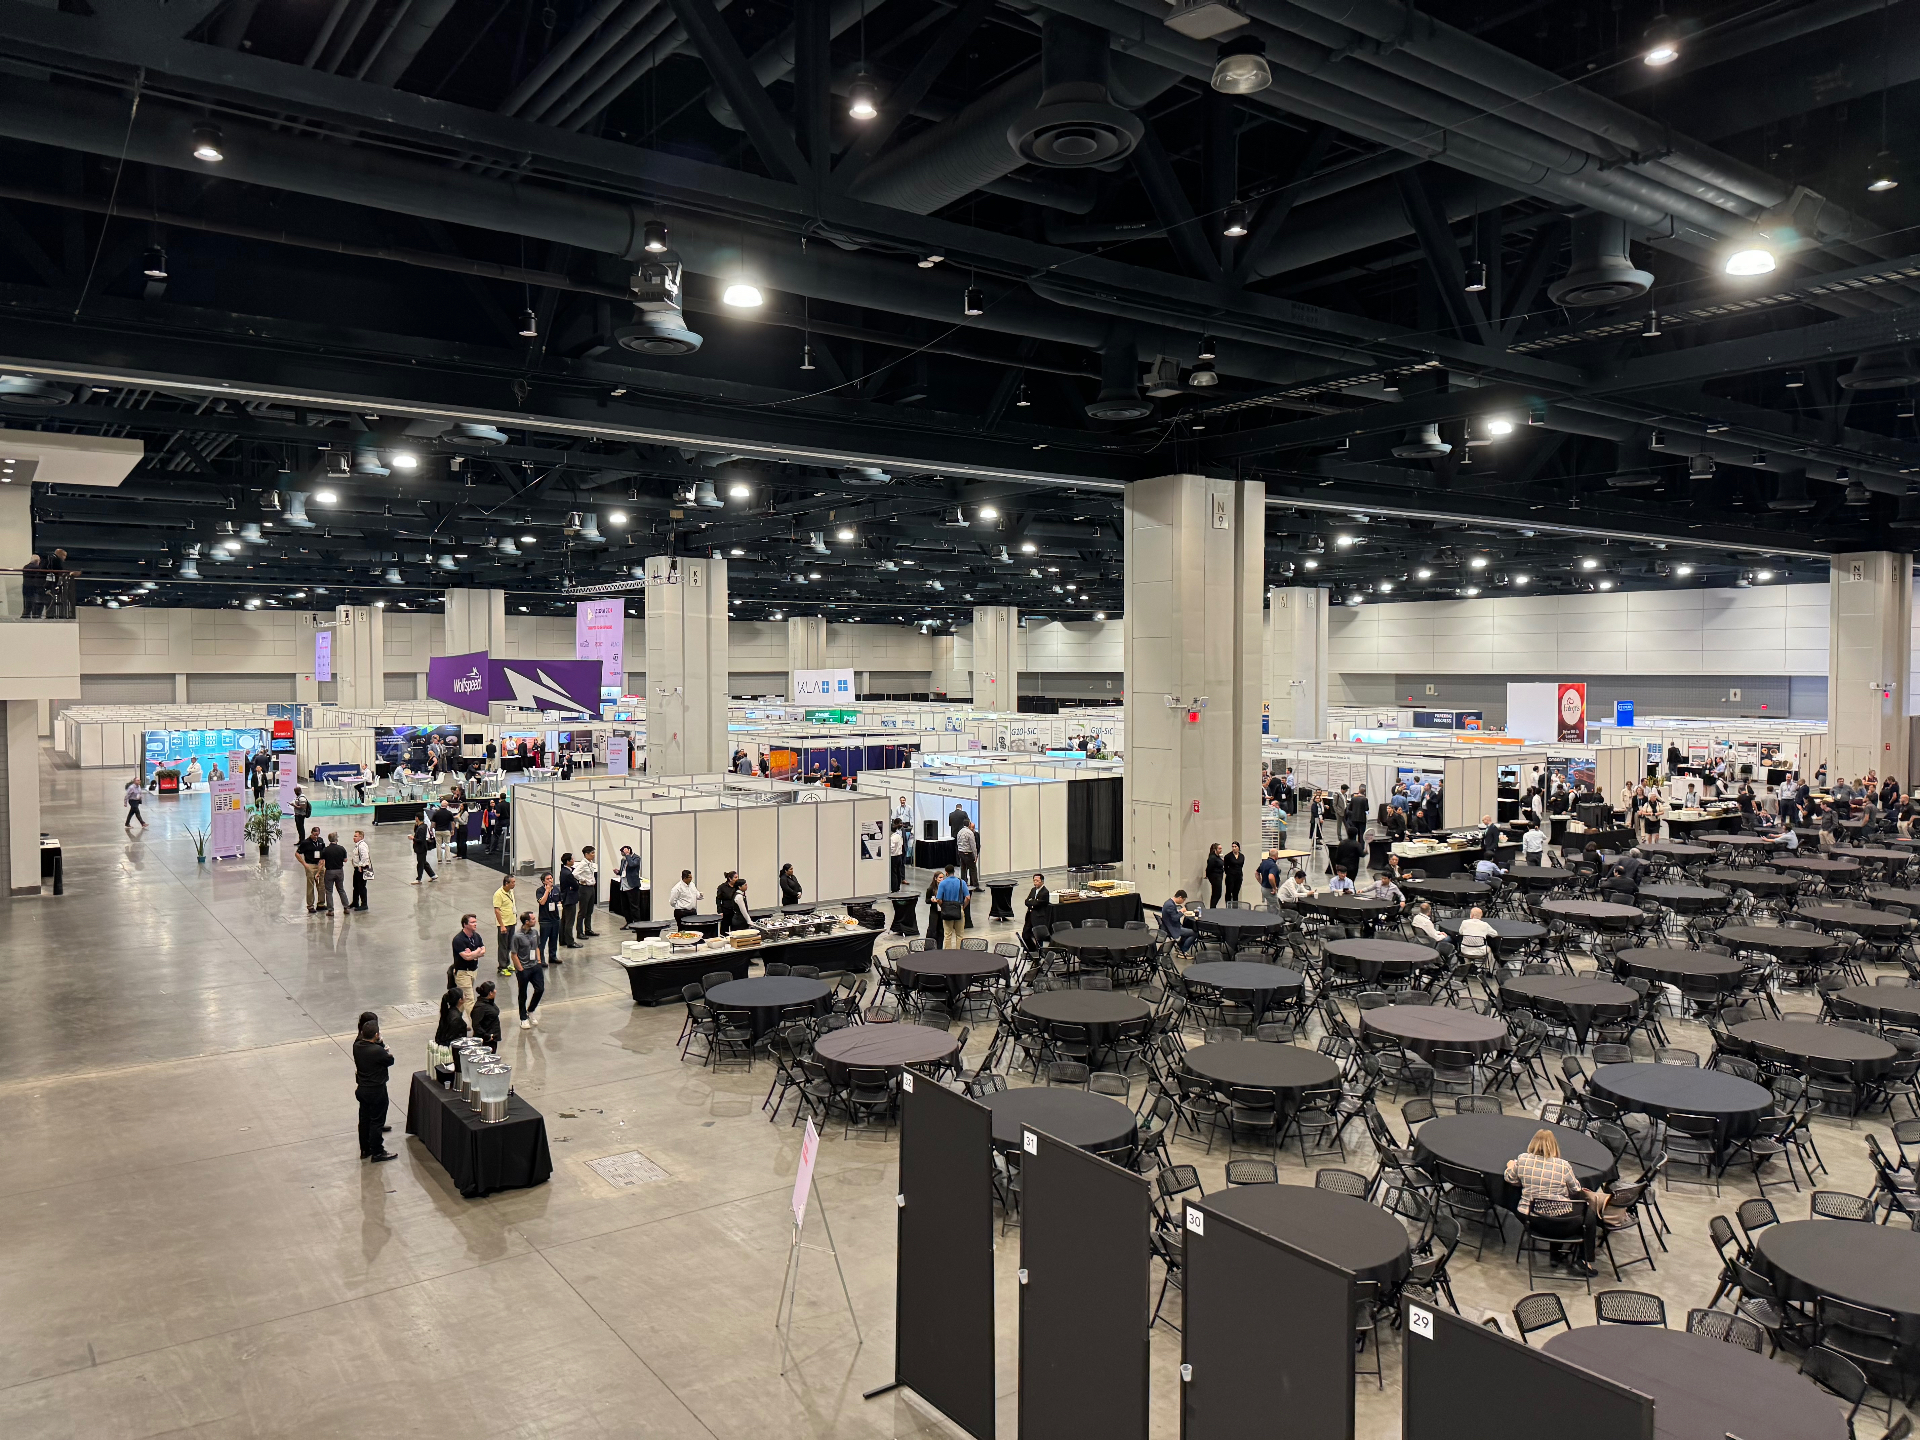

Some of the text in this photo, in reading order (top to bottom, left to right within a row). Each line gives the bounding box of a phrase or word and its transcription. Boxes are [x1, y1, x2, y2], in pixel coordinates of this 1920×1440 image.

[1217, 501, 1225, 512] N
[798, 680, 820, 694] KLA
[1012, 728, 1038, 736] G10-SiC
[1026, 1136, 1034, 1148] 31
[1189, 1214, 1200, 1228] 30
[1414, 1312, 1429, 1328] 29
